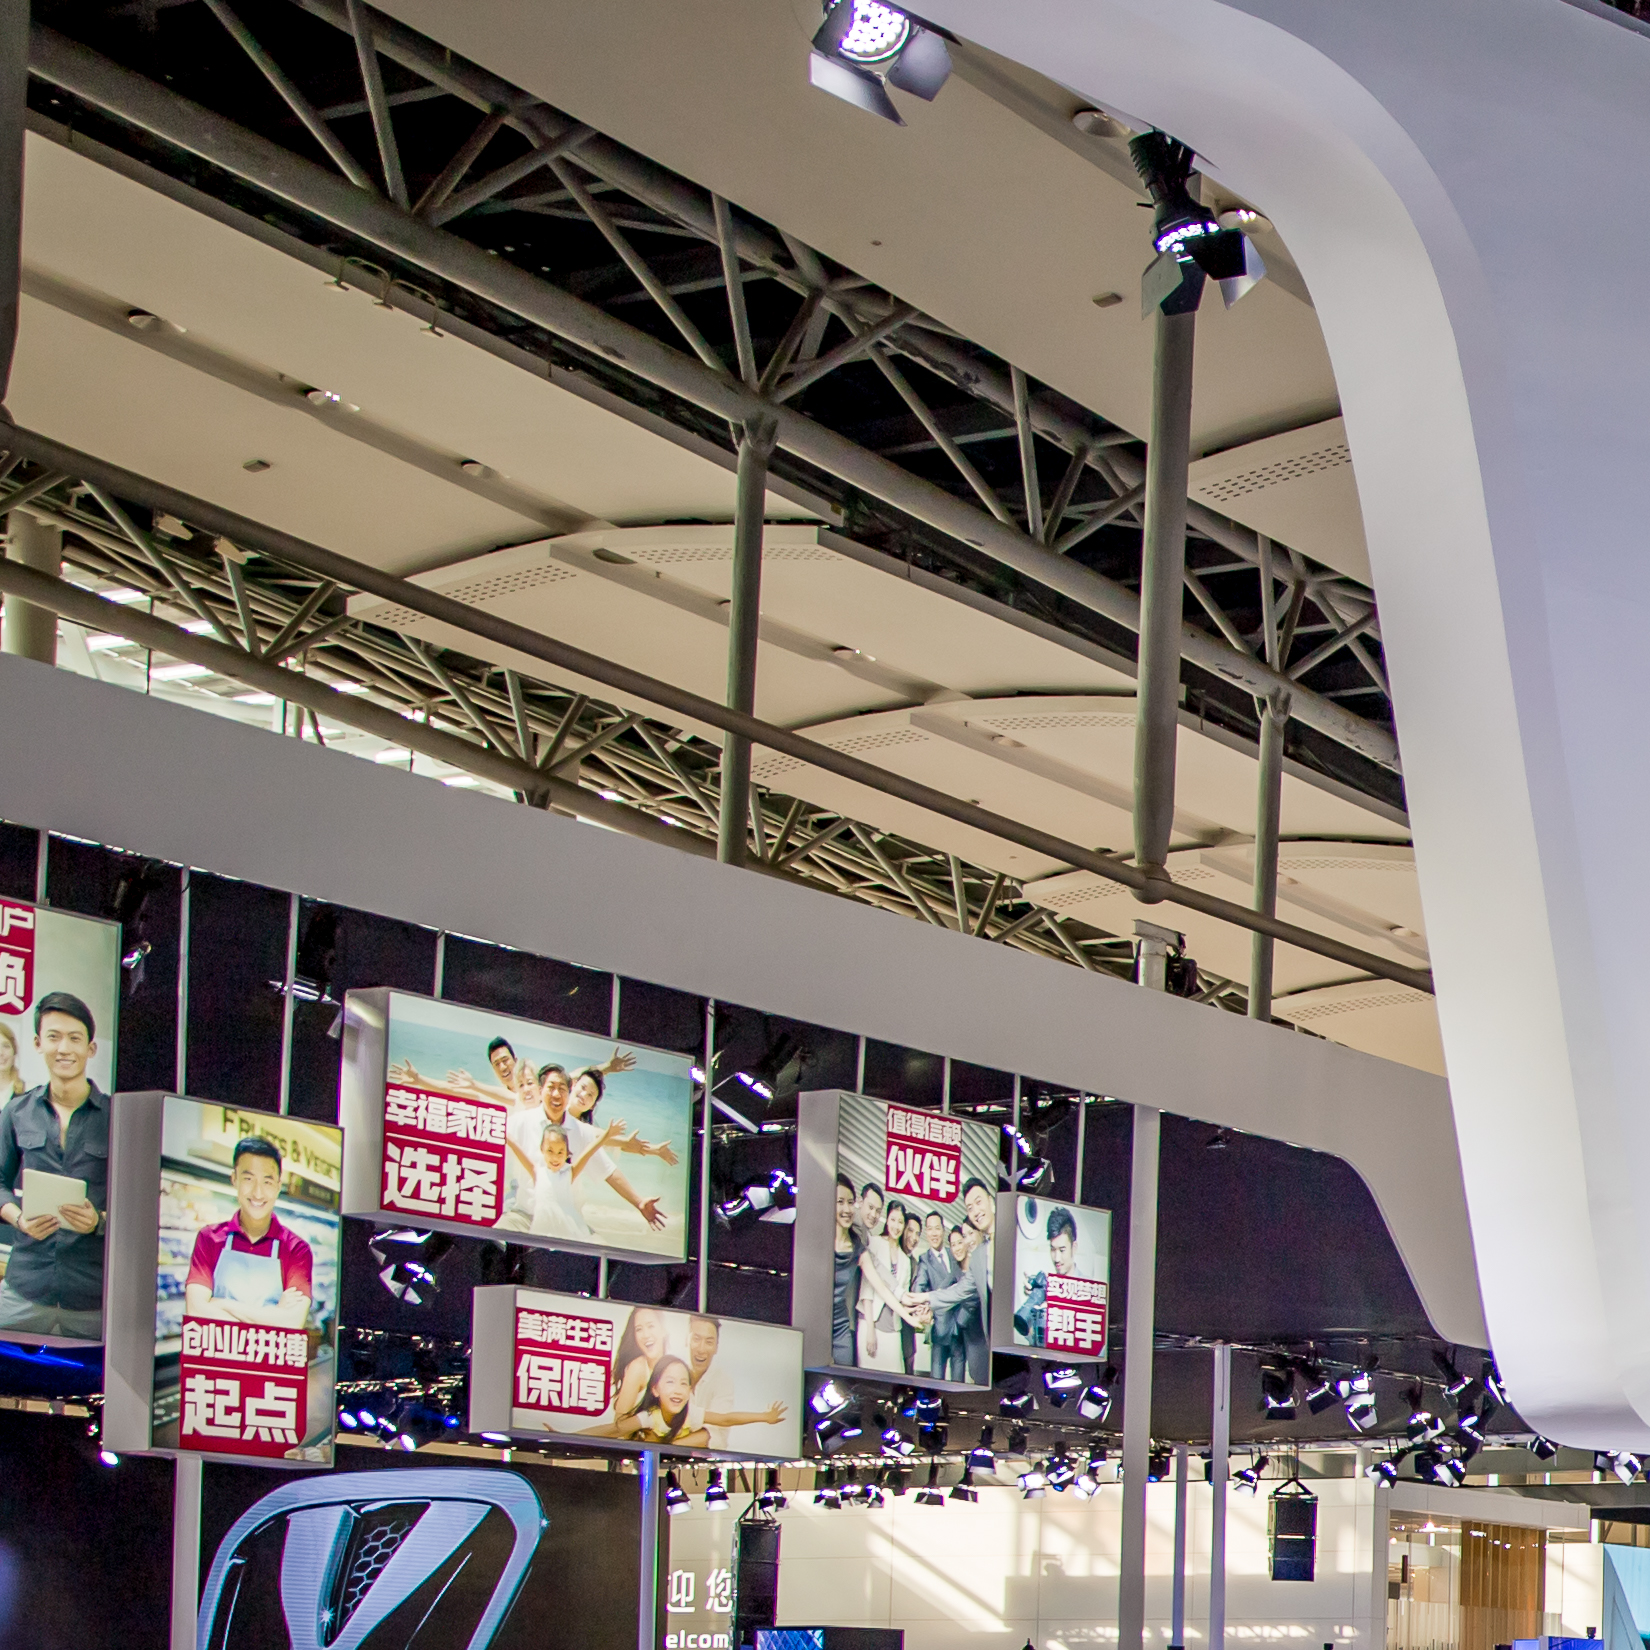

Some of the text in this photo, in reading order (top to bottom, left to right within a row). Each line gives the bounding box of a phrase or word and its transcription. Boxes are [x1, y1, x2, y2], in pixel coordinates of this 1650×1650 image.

[386, 1088, 506, 1146] 幸福家庭
[887, 1107, 962, 1147] 值得信赖
[382, 1142, 500, 1223] 选择
[886, 1144, 957, 1199] 伙伴
[182, 1321, 309, 1368] 创业拼搏
[517, 1310, 613, 1351] 美满生活
[1046, 1306, 1102, 1349] 帮手
[182, 1373, 300, 1444] 起点
[516, 1355, 607, 1412] 保障
